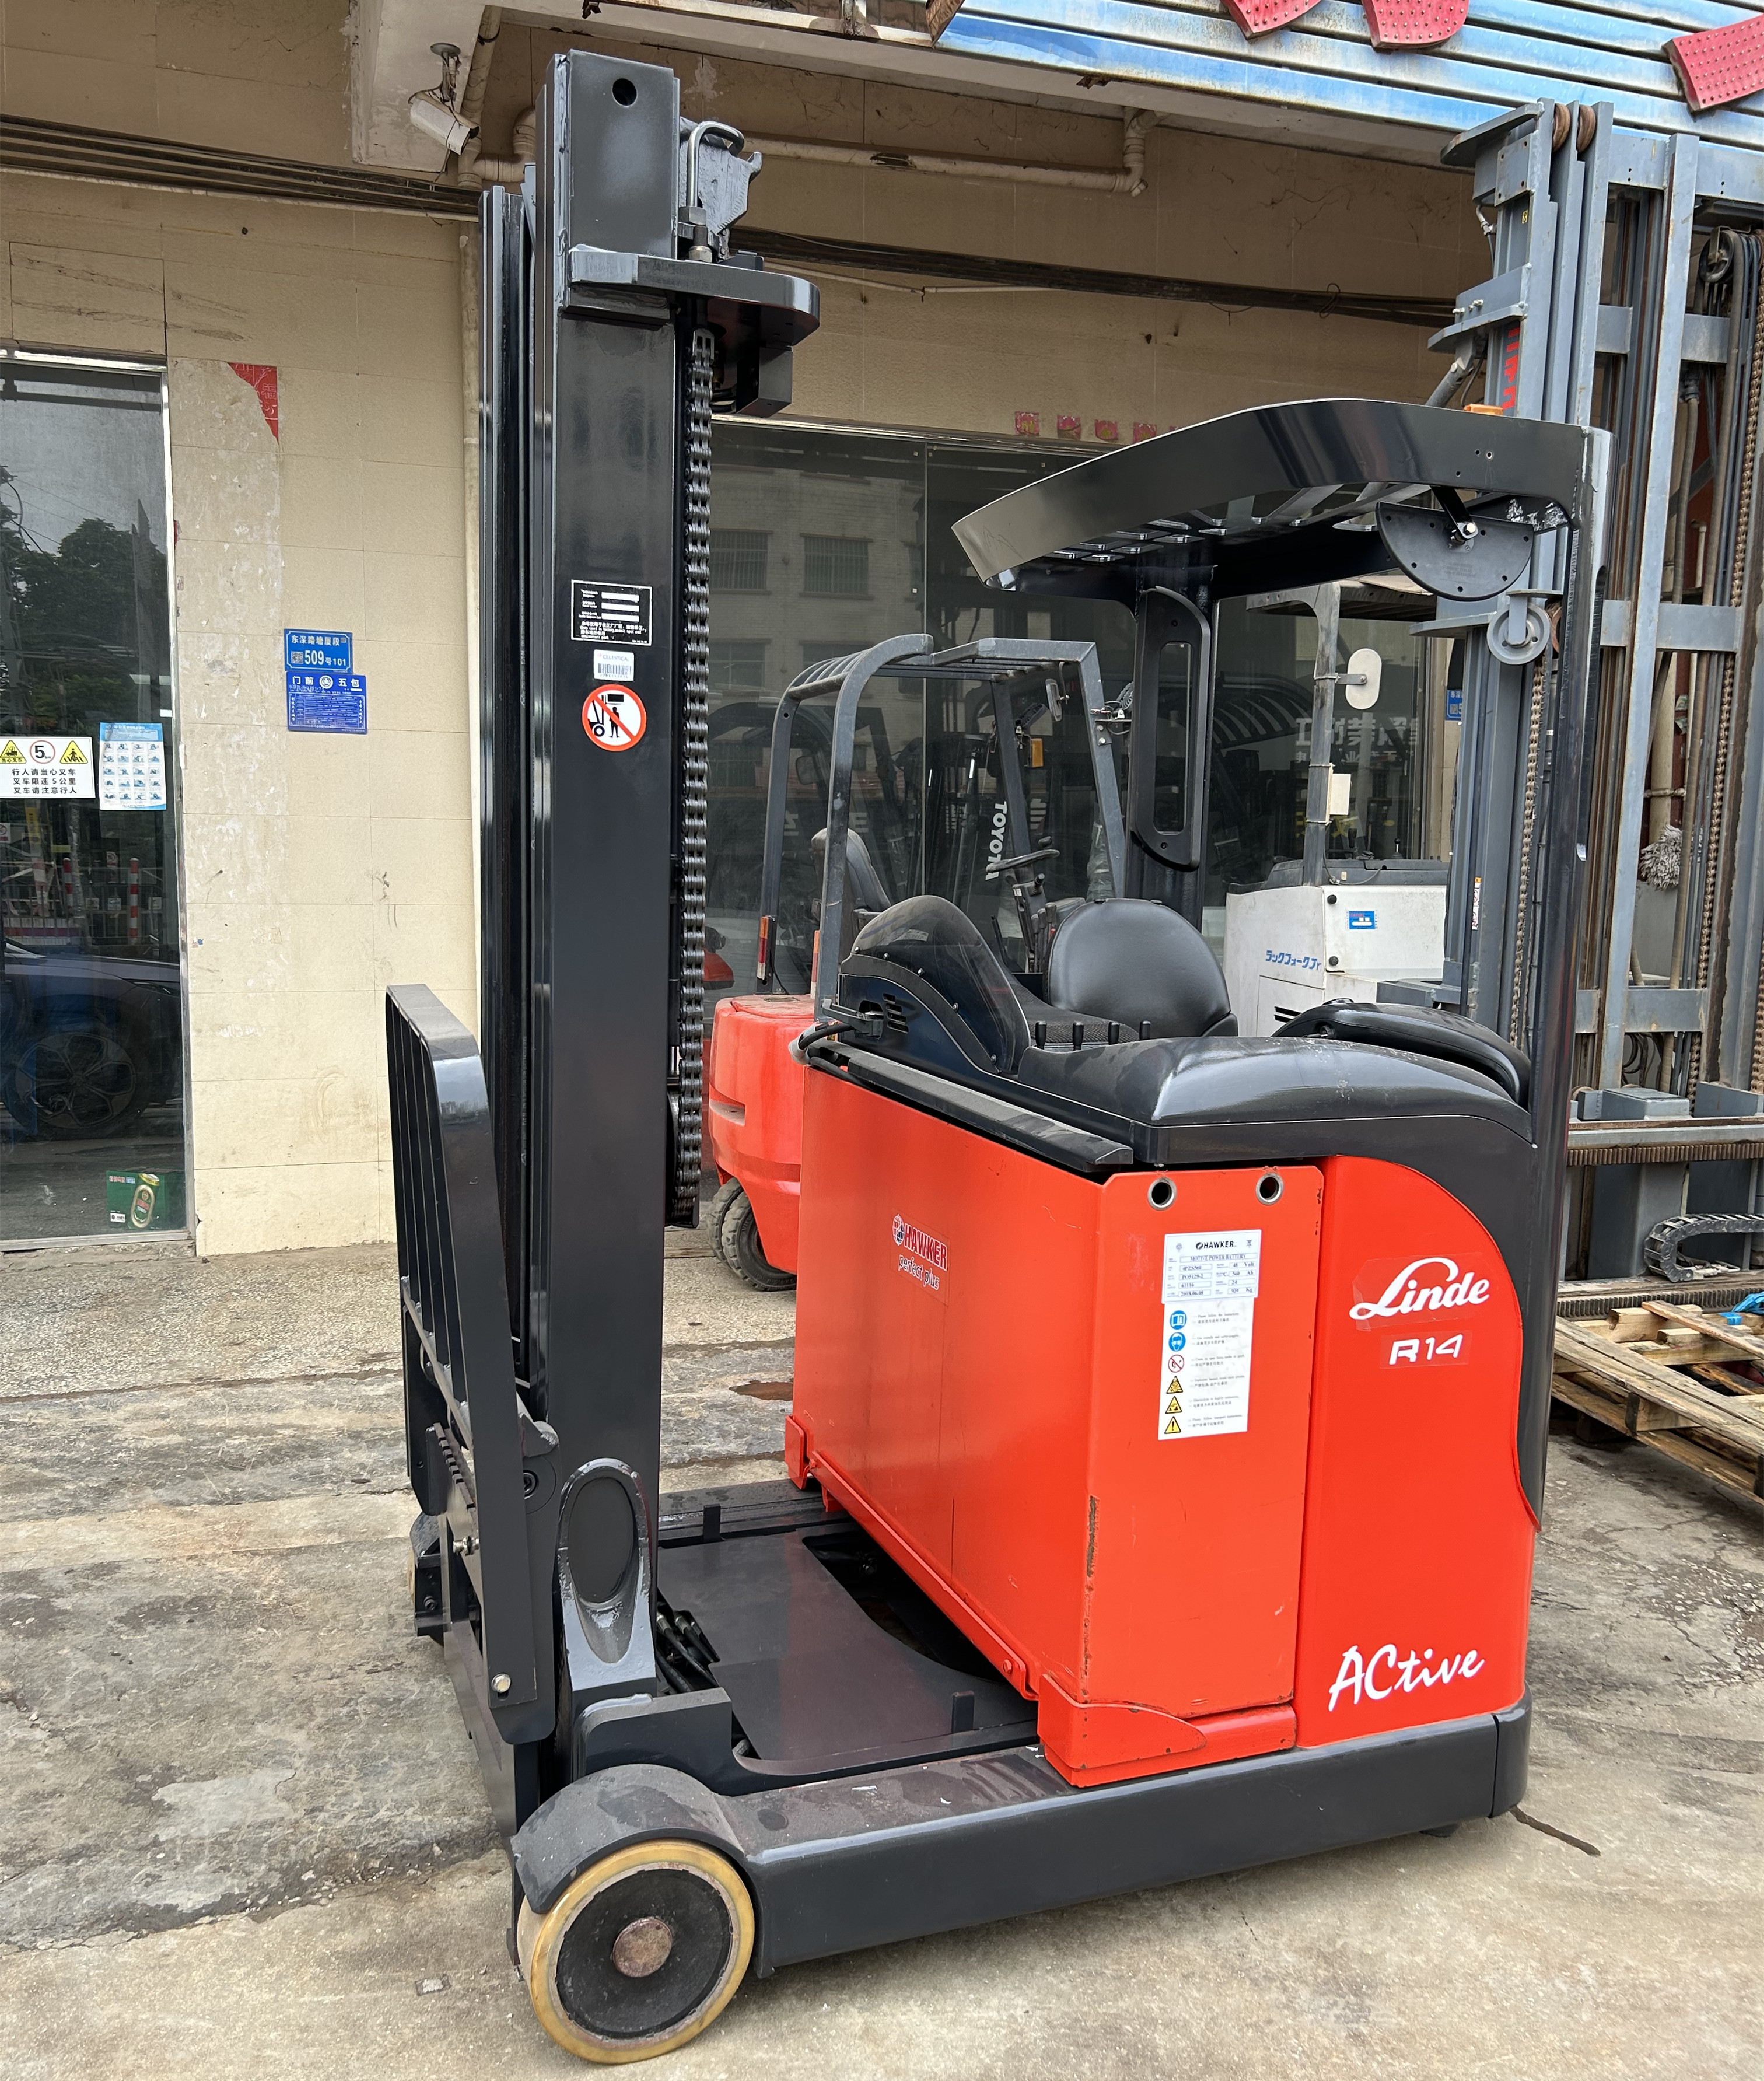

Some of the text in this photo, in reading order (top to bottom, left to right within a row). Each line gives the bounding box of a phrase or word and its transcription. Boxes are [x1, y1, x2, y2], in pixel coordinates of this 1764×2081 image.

[292, 635, 340, 646] 东深路塘厦段
[292, 676, 359, 687] 门前 五包
[904, 1223, 948, 1272] HAWKER
[1203, 1241, 1234, 1249] HAWKER
[898, 1255, 940, 1290] perfect plus
[1349, 1257, 1489, 1320] Linde
[1389, 1334, 1463, 1365] R14
[1328, 1643, 1485, 1712] ACtive
